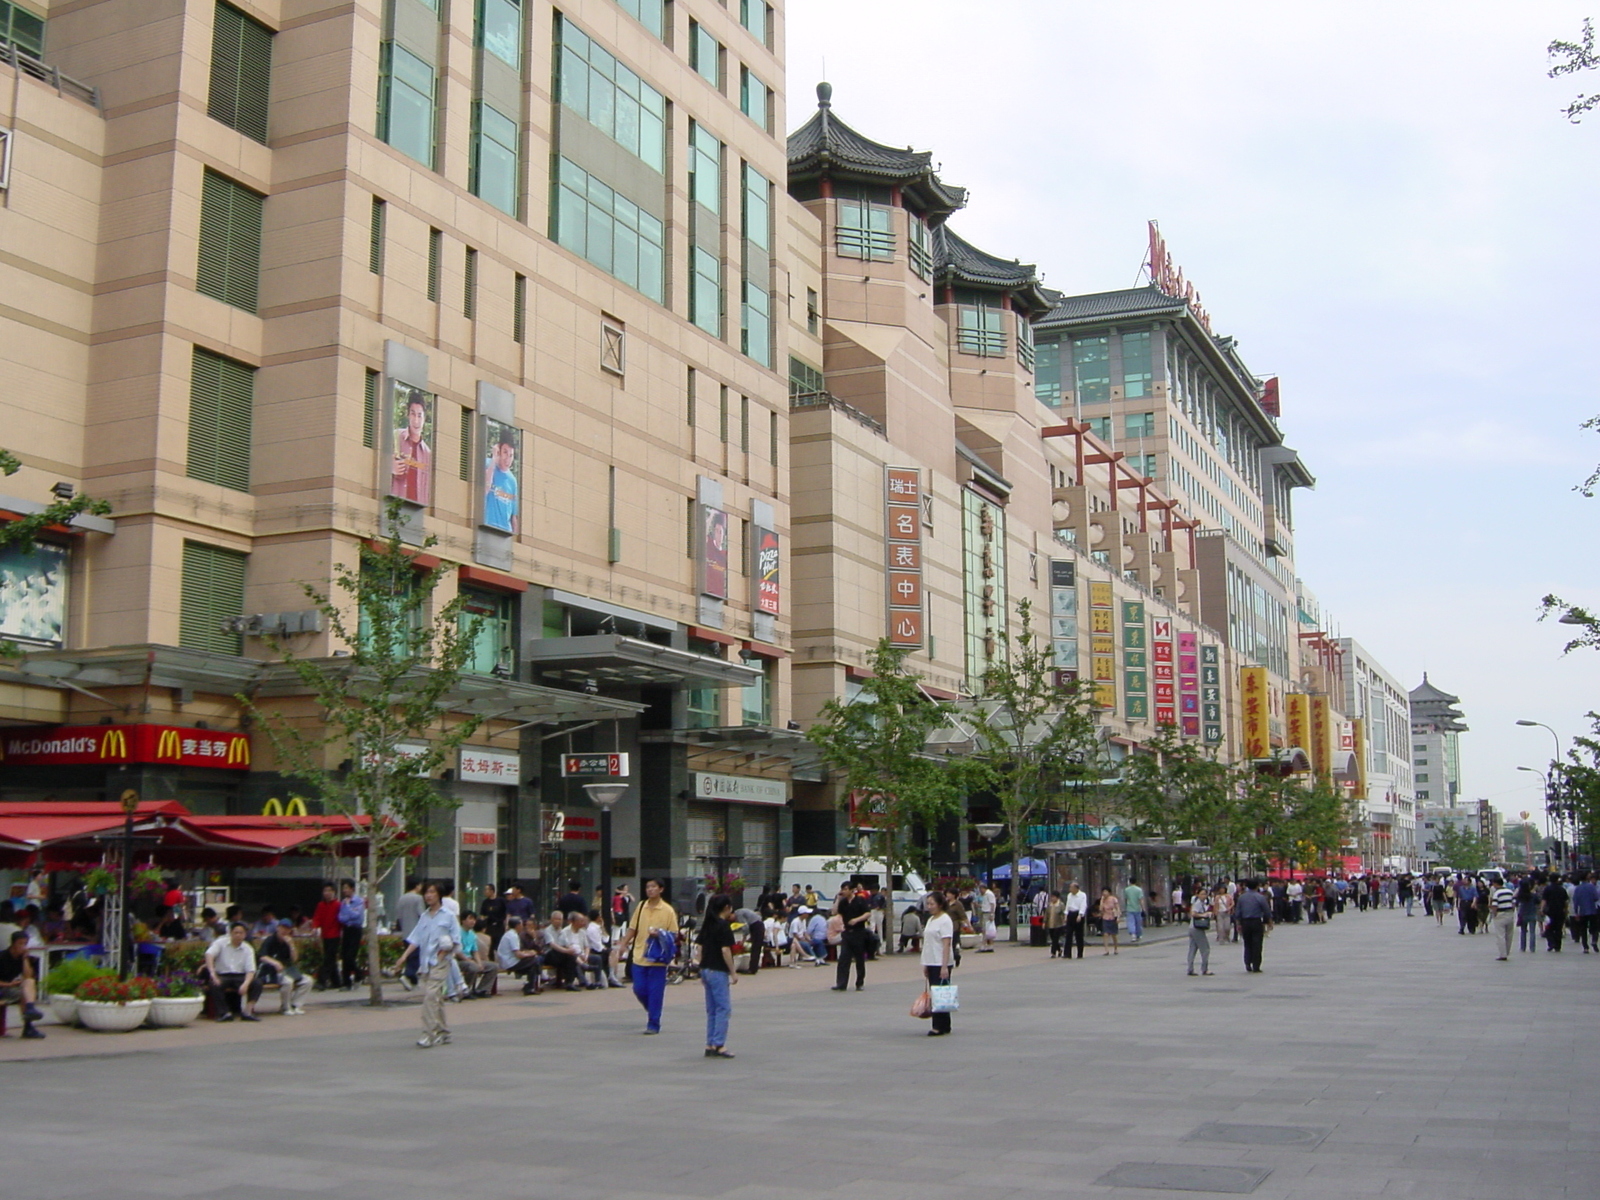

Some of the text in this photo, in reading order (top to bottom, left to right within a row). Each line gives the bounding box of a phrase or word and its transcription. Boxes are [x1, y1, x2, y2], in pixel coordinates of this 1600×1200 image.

[759, 548, 778, 571] Pizza
[889, 478, 917, 637] 瑞士名表中心
[763, 559, 777, 576] Hut
[8, 737, 97, 756] McDonald's
[182, 738, 228, 757] 麦当劳
[610, 758, 619, 771] 2
